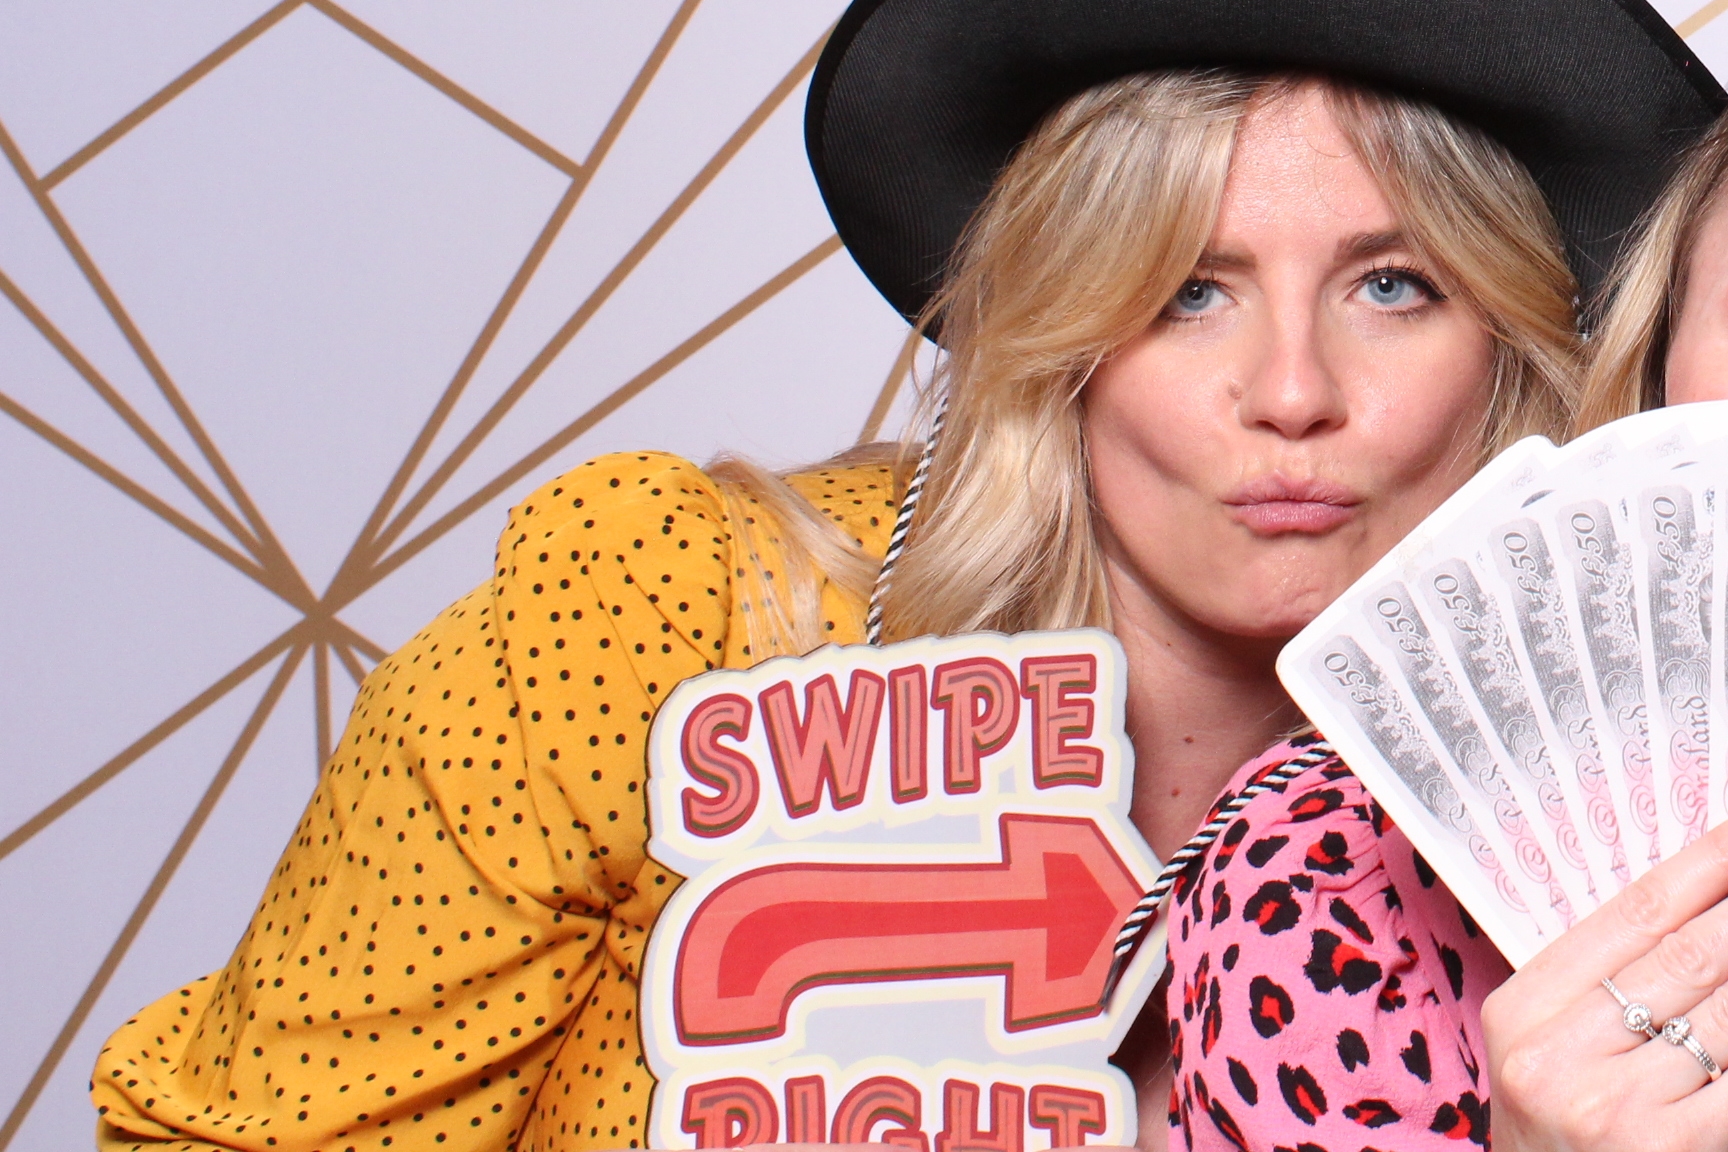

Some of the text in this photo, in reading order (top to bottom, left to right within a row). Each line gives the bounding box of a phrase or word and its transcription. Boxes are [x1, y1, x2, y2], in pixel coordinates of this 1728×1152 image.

[1503, 532, 1545, 601] £50
[1571, 513, 1608, 584] £50
[1653, 496, 1682, 570] £50
[1376, 597, 1430, 660] £50
[1433, 574, 1481, 639] £50
[1323, 652, 1380, 710] £50
[681, 654, 1104, 838] SWIPE
